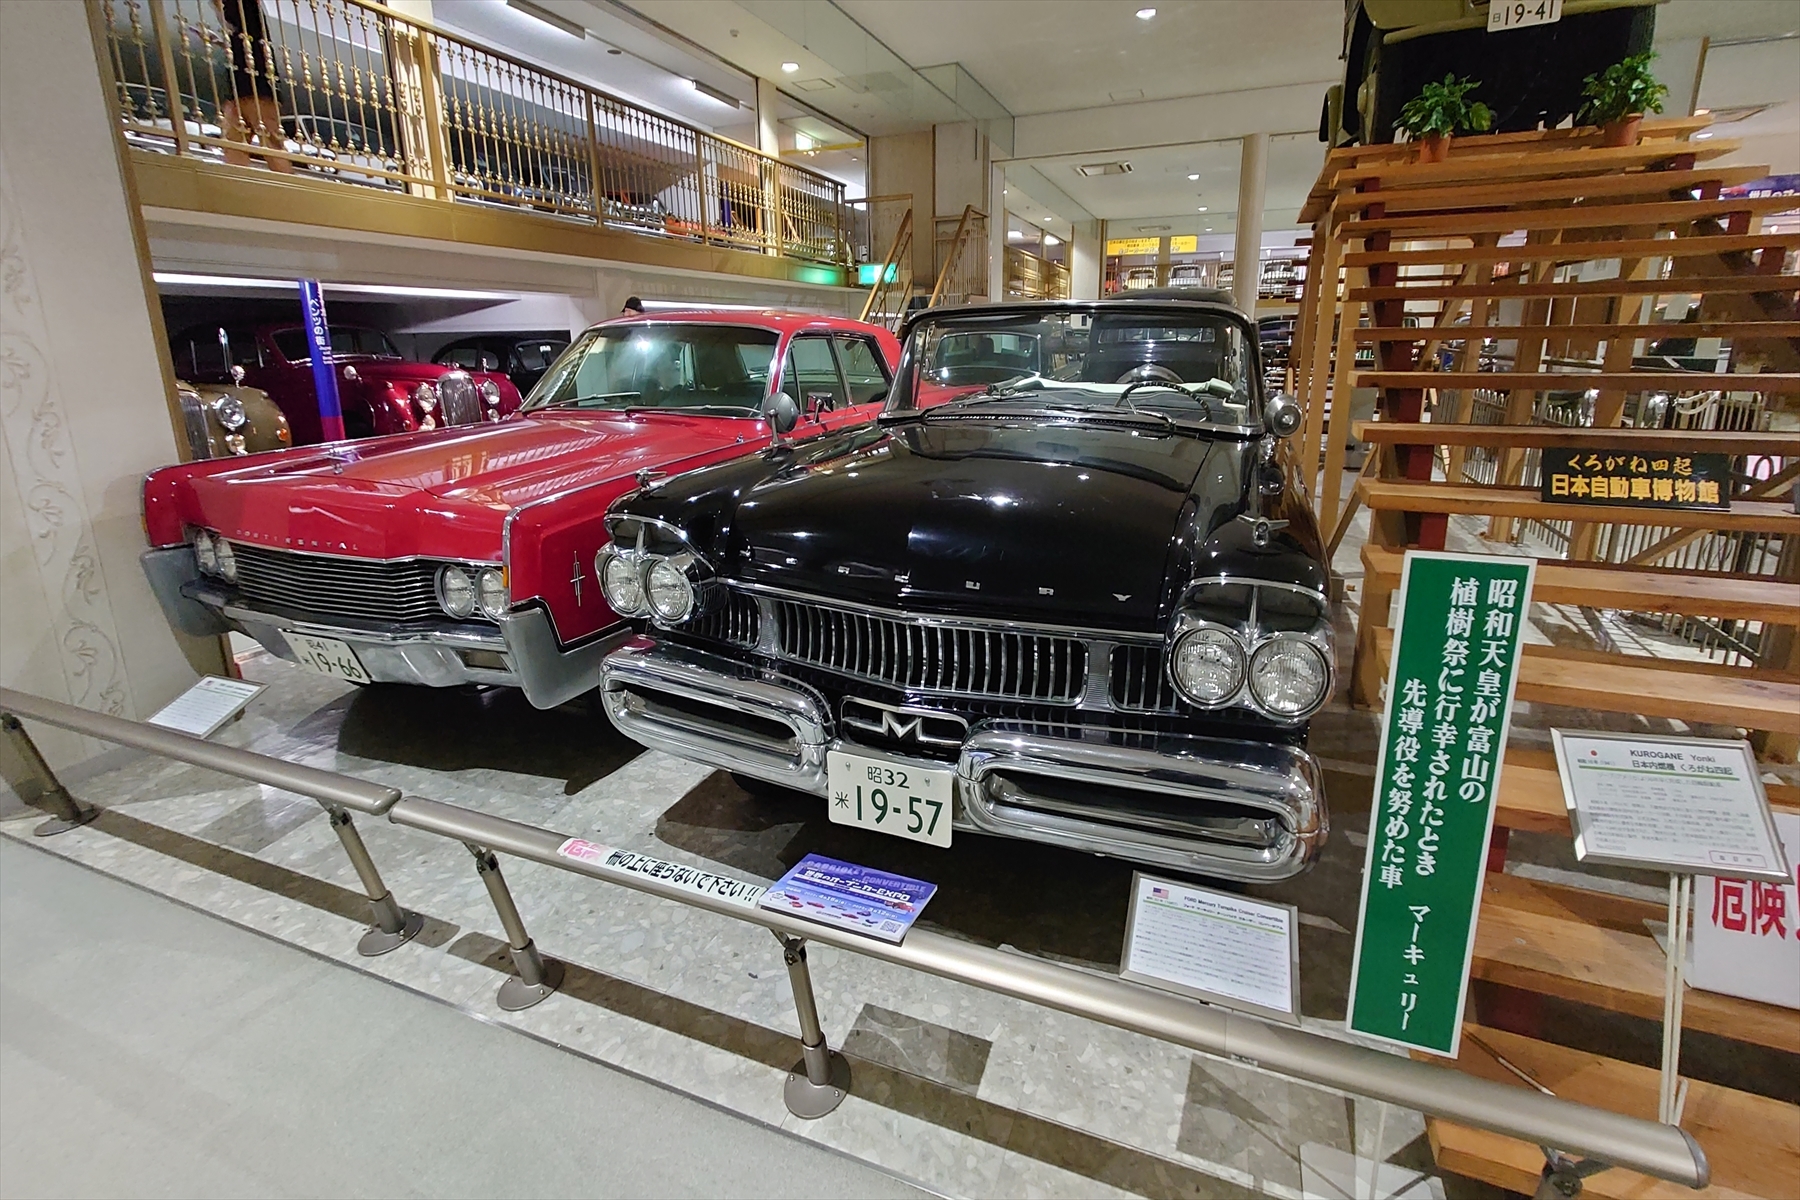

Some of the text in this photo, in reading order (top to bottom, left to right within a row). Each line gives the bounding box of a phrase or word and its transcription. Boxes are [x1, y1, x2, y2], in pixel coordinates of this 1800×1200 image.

[1504, 0, 1556, 26] 19-41
[1567, 453, 1694, 476] くろがね四起
[1551, 473, 1720, 505] 日本自動車博物館
[307, 650, 363, 679] 19-66
[1459, 578, 1519, 804] 昭和天皇が富山の
[1414, 576, 1481, 877] 植樹祭に行幸されたとき
[1629, 749, 1716, 763] KUROGANE Yonki
[867, 766, 911, 790] 昭32
[1378, 677, 1429, 889] 先導役を努めた車
[834, 785, 944, 837] 米 19-57
[1399, 904, 1432, 1031] マーキュリー
